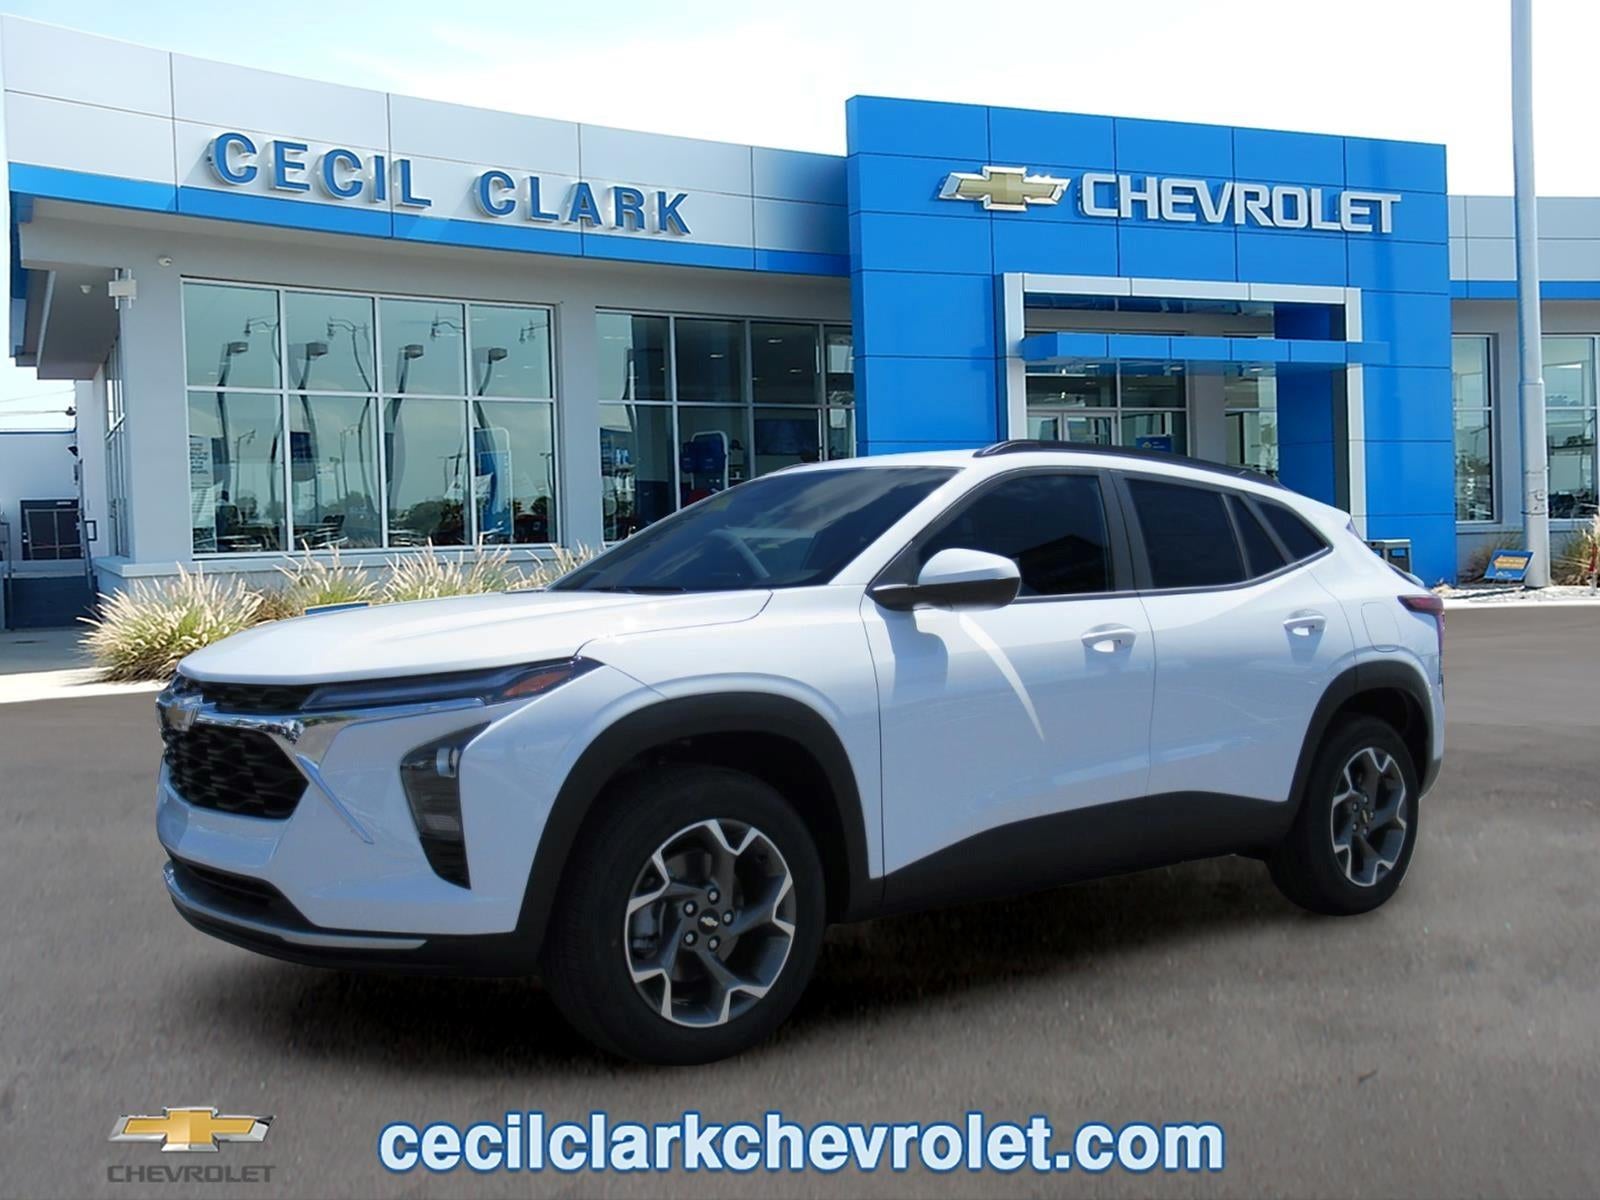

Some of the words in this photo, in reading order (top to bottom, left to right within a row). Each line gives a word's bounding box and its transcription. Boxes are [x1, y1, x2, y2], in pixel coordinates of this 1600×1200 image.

[208, 131, 432, 208] CECIL
[474, 170, 692, 236] CLARK
[1079, 172, 1402, 234] CHEVROLET
